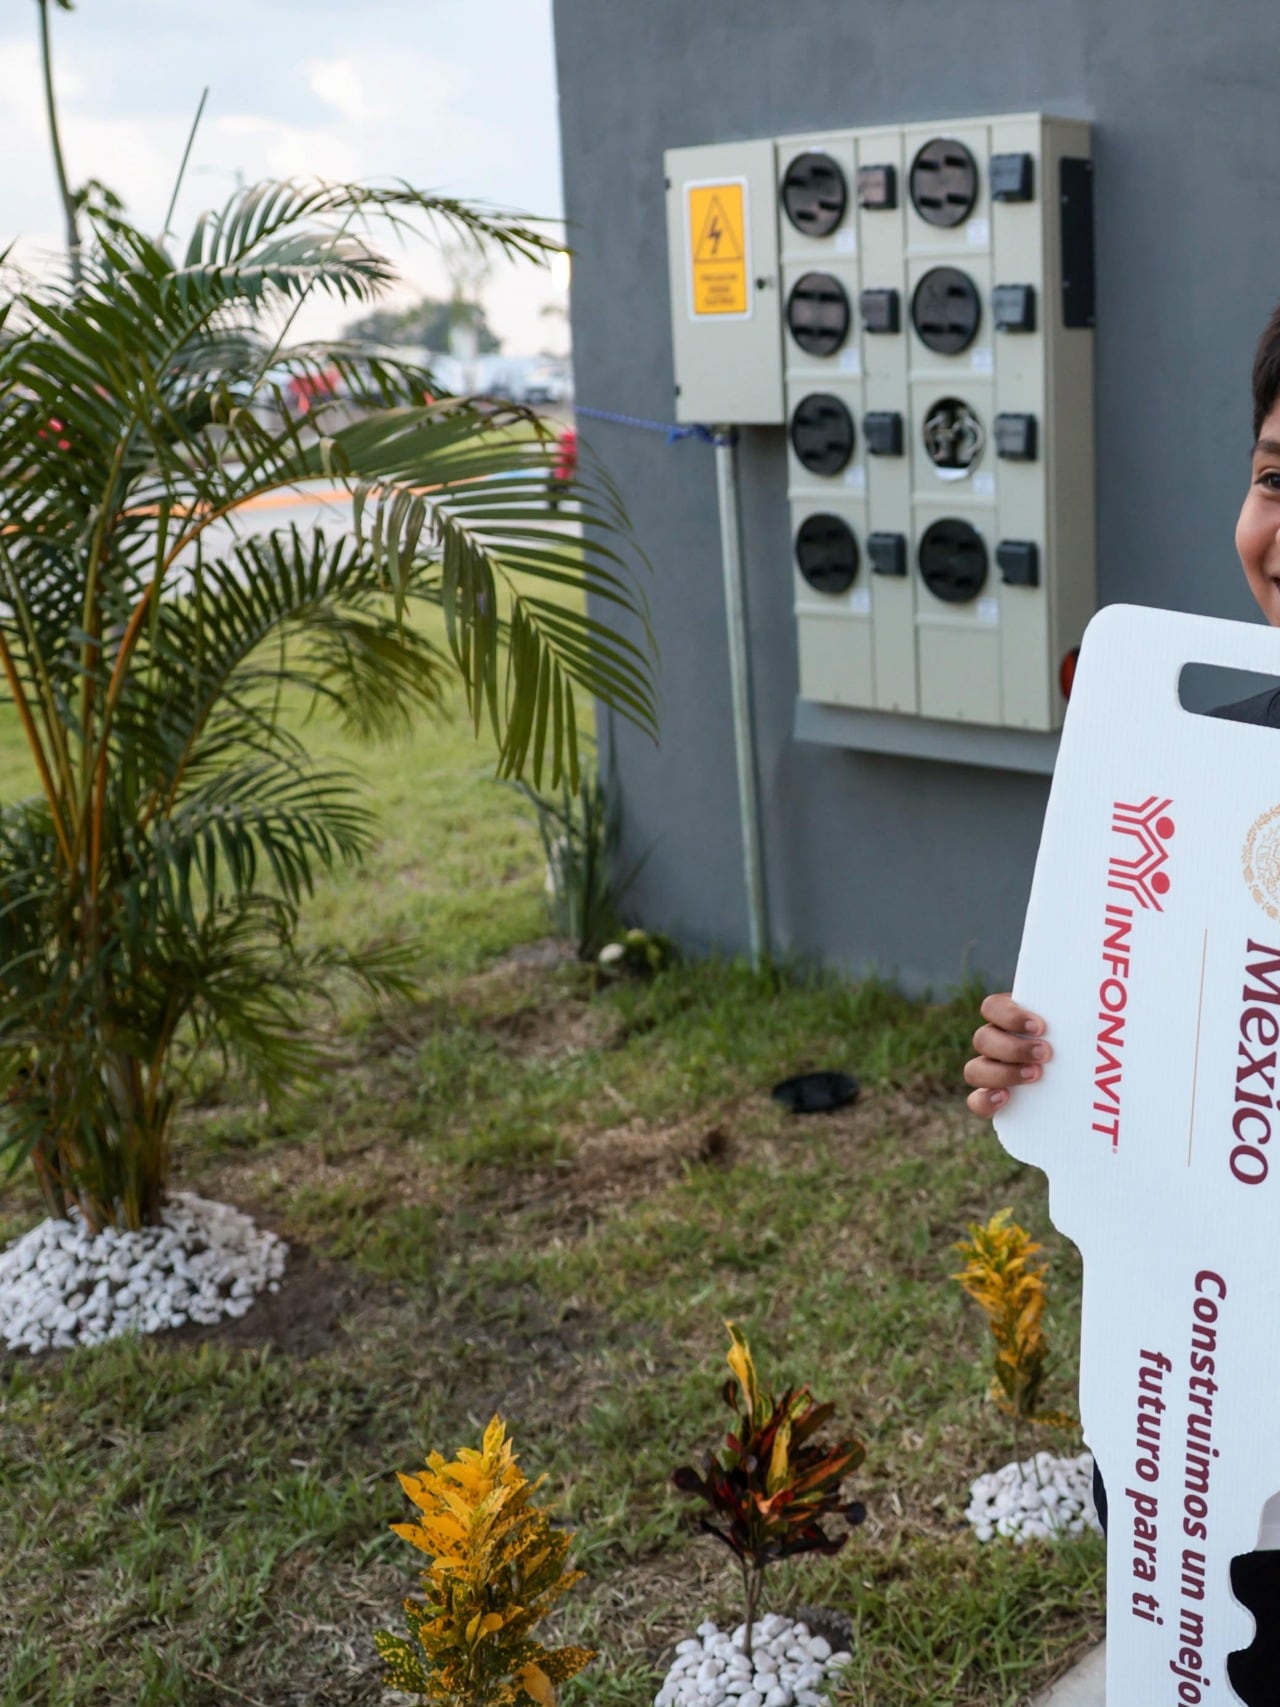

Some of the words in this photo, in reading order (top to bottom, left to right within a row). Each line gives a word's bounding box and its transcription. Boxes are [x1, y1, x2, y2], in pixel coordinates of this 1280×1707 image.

[1091, 904, 1133, 1147] INFONAVIT
[1134, 1349, 1172, 1483] futuro
[1182, 1270, 1227, 1541] Construimos
[1125, 1487, 1160, 1583] para
[1180, 1549, 1206, 1601] un
[1131, 1592, 1164, 1626] ti
[1169, 1608, 1211, 1707] mejo
